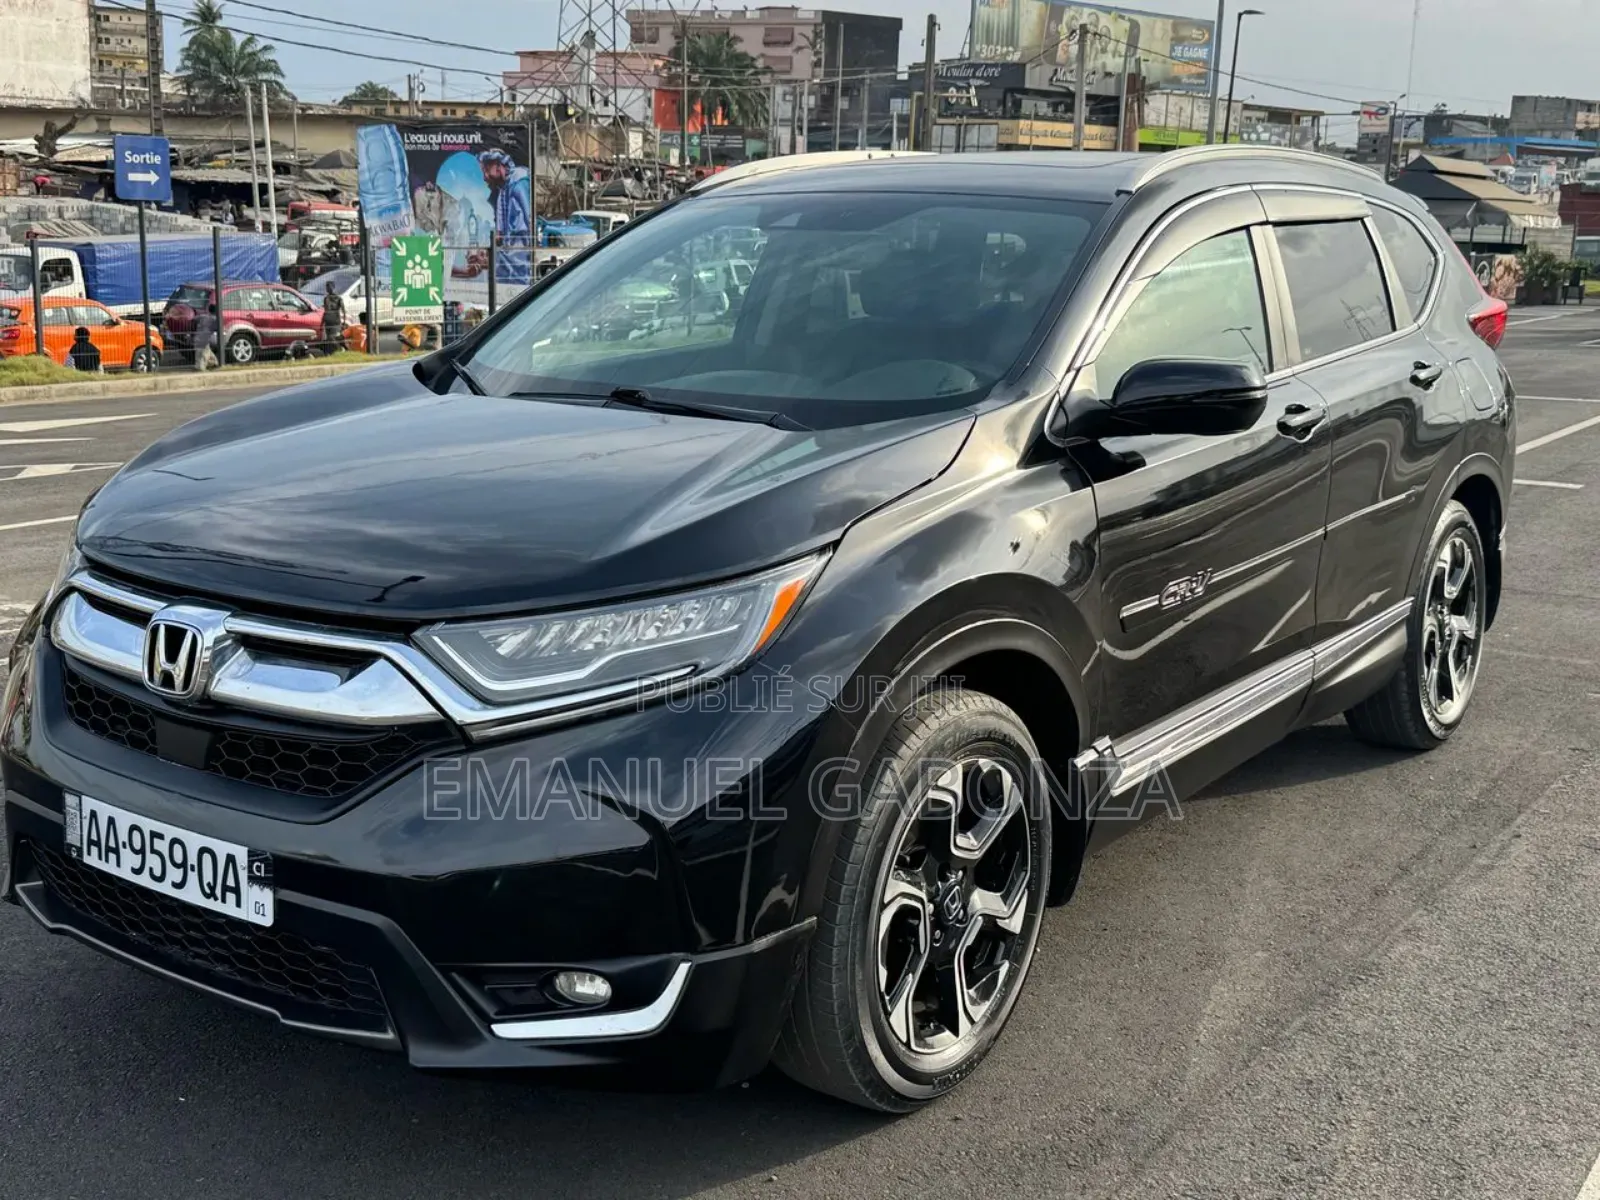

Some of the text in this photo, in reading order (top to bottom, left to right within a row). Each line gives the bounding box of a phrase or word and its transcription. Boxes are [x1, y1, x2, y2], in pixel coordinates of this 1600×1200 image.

[935, 64, 974, 77] Moulin
[404, 132, 427, 143] L'eau
[429, 132, 442, 147] qui
[443, 133, 465, 143] nous
[417, 143, 431, 151] mois
[432, 143, 440, 151] de
[124, 150, 161, 165] Sortie
[395, 314, 442, 322] RASSEMBLEMENT
[252, 861, 265, 877] CI
[254, 901, 266, 917] 01
